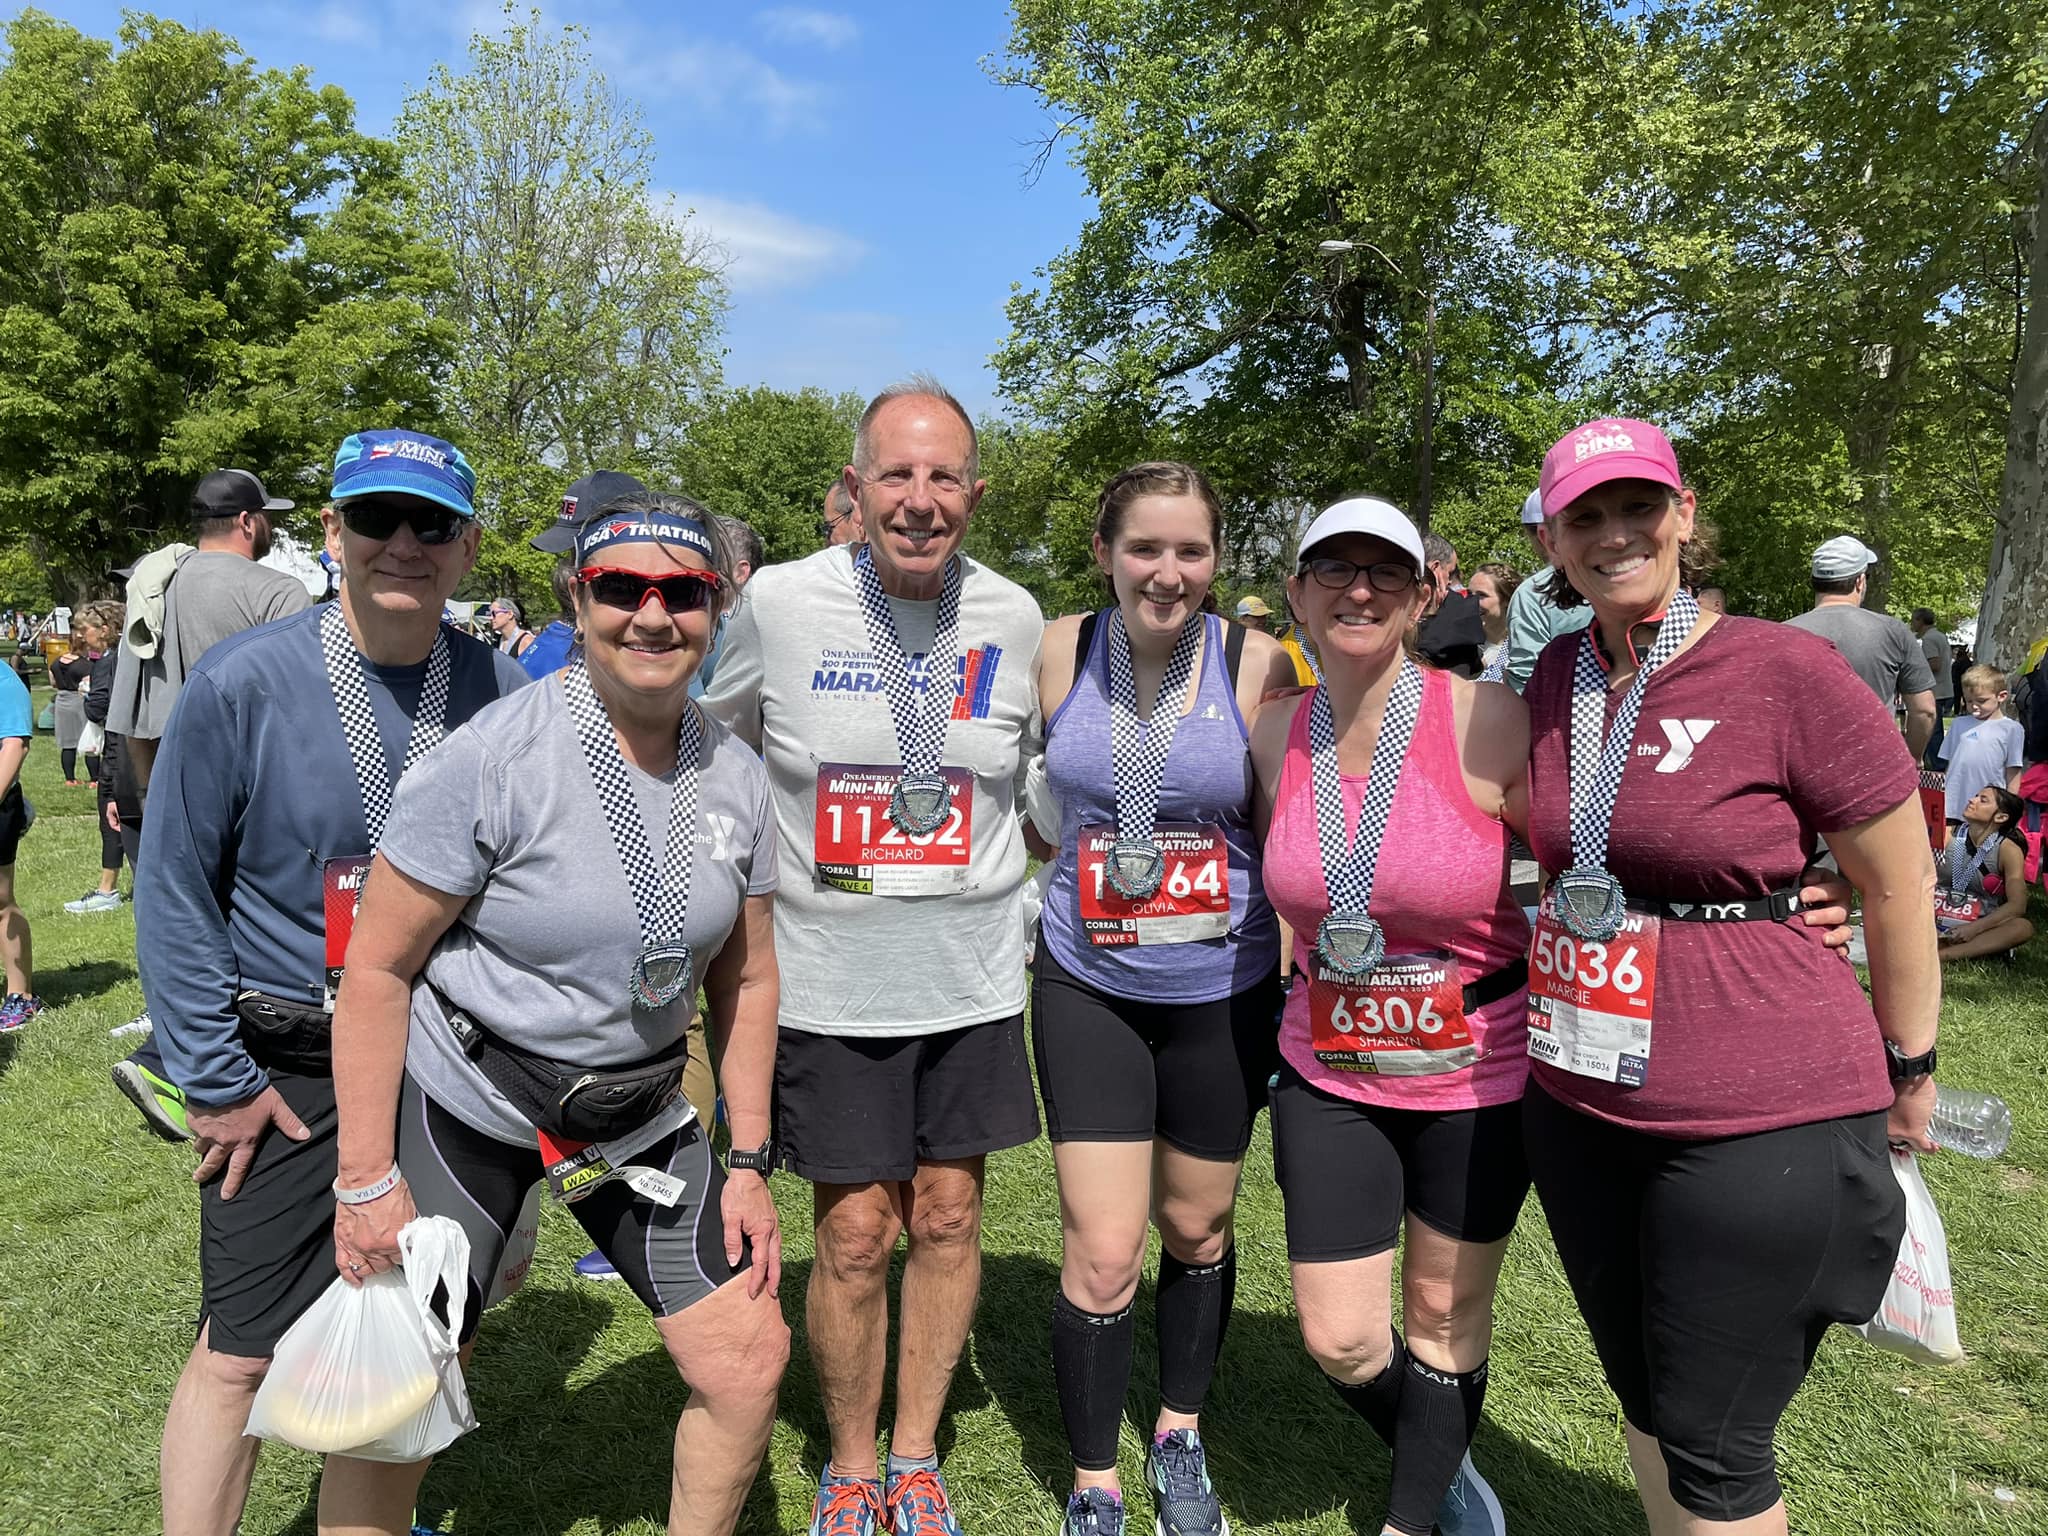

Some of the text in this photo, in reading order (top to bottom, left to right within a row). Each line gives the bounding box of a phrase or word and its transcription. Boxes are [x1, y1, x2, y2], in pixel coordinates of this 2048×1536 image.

[400, 443, 446, 464] MINI
[396, 452, 445, 470] MARATHON
[583, 524, 713, 553] USA TRIATHLON
[842, 661, 880, 670] FESTIV
[1637, 743, 1661, 756] the
[826, 804, 963, 846] 1122
[693, 831, 713, 845] the
[861, 848, 925, 861] RICHARD
[820, 865, 868, 876] CORRAL T
[831, 879, 868, 891] WAVE 4
[1088, 860, 1221, 900] 164
[1132, 903, 1177, 915] OLIVIA
[1701, 903, 1746, 919] TYR
[1085, 921, 1119, 929] CORRAL
[1126, 920, 1132, 930] S
[1096, 934, 1134, 943] WAVE 3
[1392, 963, 1431, 971] FESTIVAL
[1318, 967, 1446, 986] MINI-MARATHON
[1546, 980, 1591, 1005] MARGIE
[1543, 1000, 1550, 1011] N
[1331, 995, 1444, 1034] 6306
[1542, 1017, 1548, 1028] 3
[1359, 1035, 1422, 1047] SHARLYN
[1532, 1037, 1560, 1056] MINI
[1319, 1053, 1372, 1062] CORRAL W
[1333, 1064, 1362, 1072] WAVE
[1586, 1060, 1611, 1072] 15036
[552, 1148, 597, 1176] CORRAL V
[566, 1166, 601, 1188] WAVE
[599, 1162, 607, 1173] 4
[652, 1184, 674, 1198] 13455
